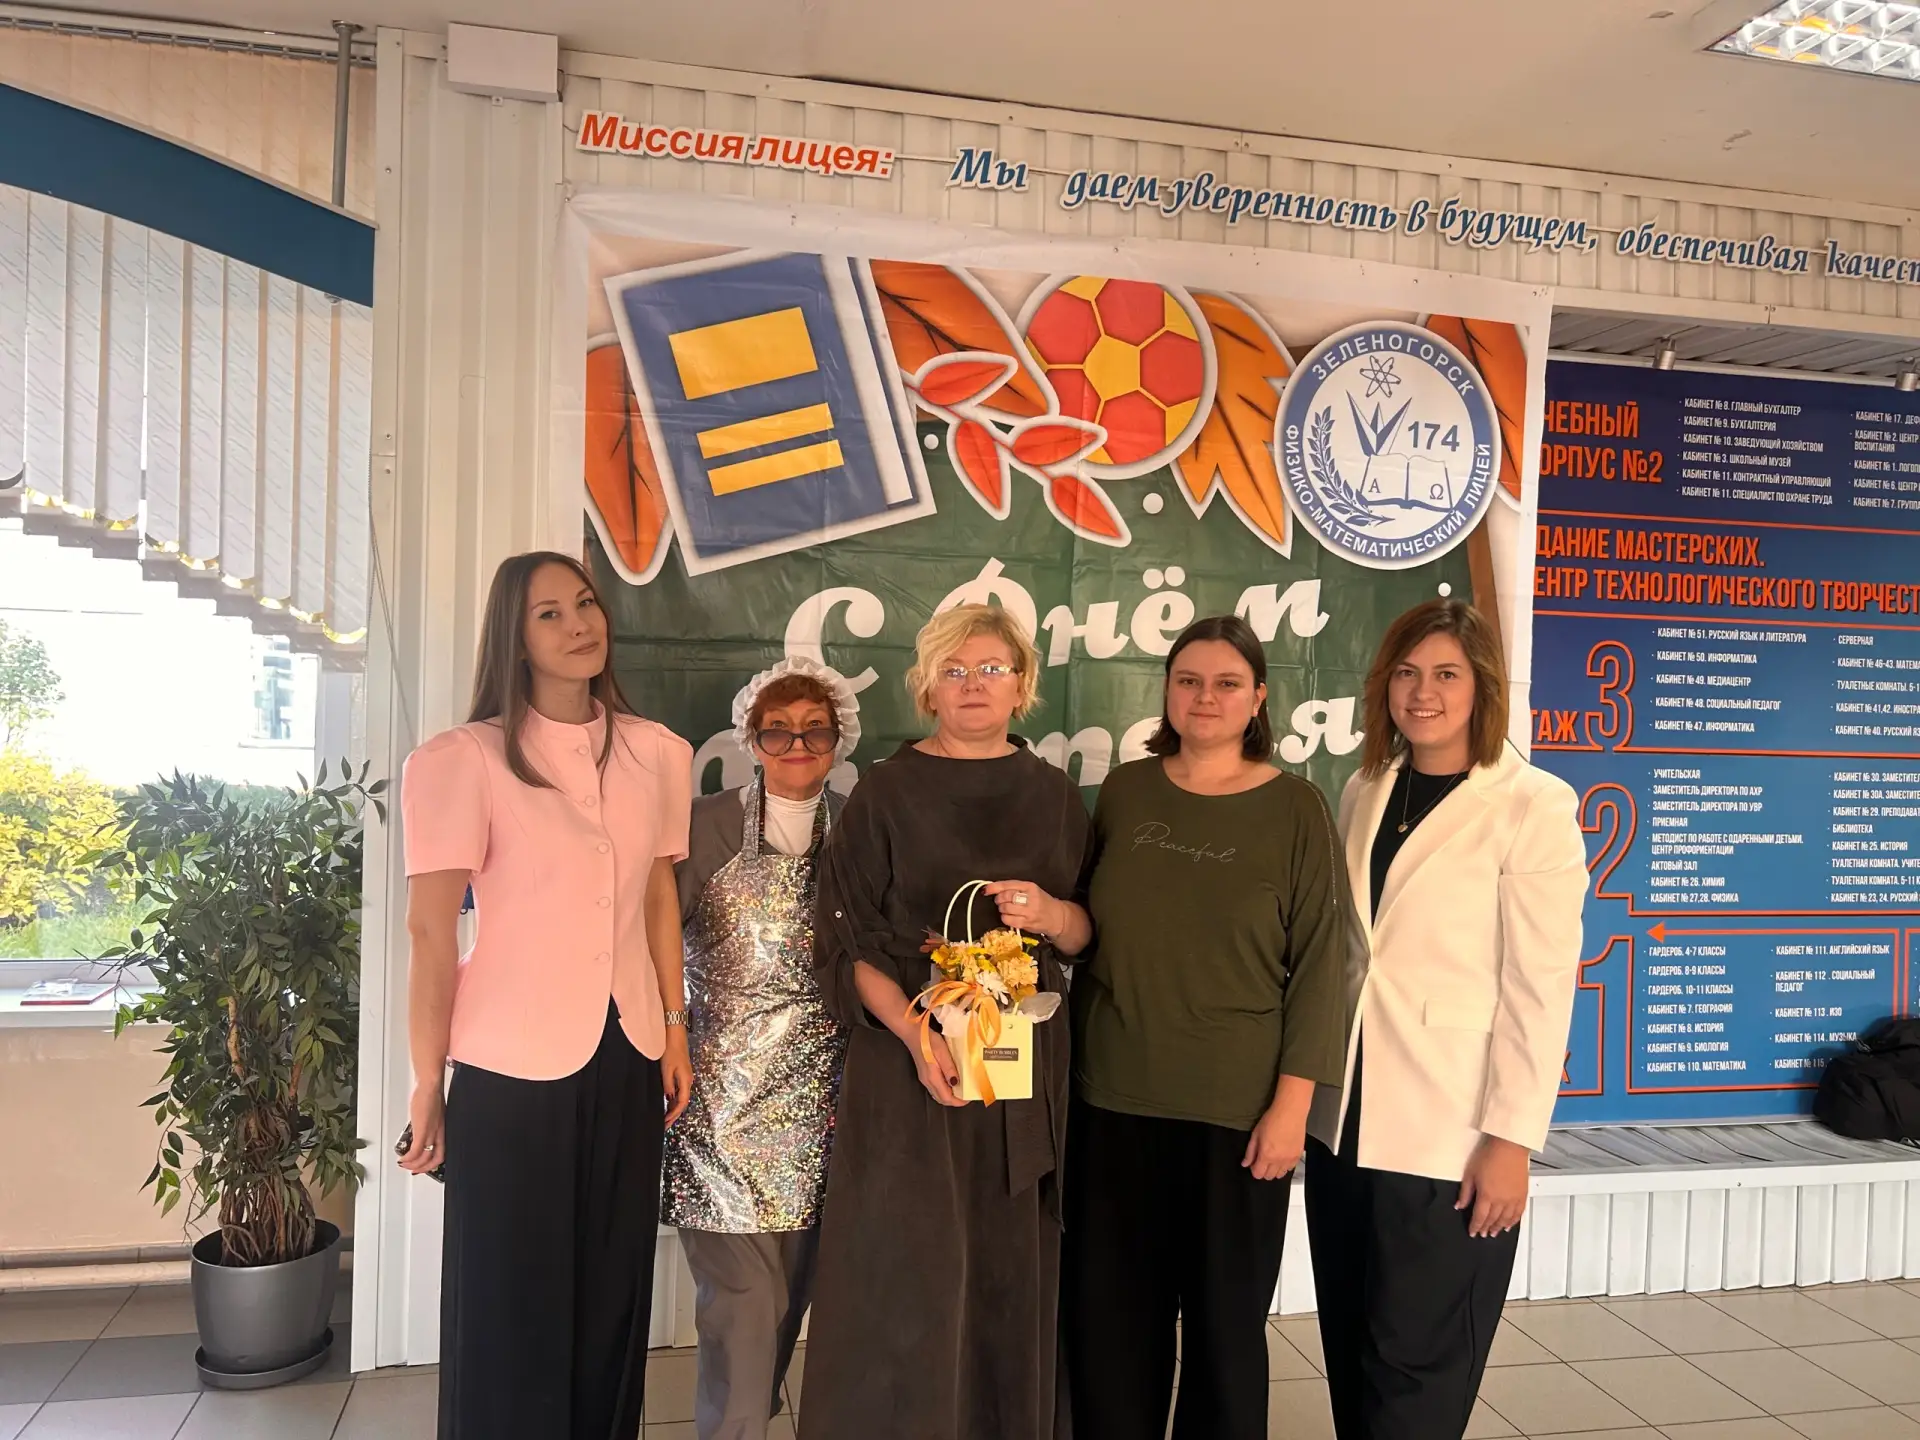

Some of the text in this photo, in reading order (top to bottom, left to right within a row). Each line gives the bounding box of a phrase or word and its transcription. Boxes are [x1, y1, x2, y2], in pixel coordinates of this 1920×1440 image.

[580, 114, 892, 175] Миссия лицея:
[950, 148, 1028, 188] Мы
[1065, 172, 1158, 207] даем
[1164, 173, 1397, 229] уверенность
[1407, 201, 1431, 232] в
[1439, 198, 1598, 250] будущем,
[1619, 218, 1808, 272] обеспечивая
[1312, 334, 1474, 396] ЗЕЛЕНОГОРСК
[1685, 398, 1714, 409] КАБИНЕТ
[1715, 401, 1722, 410] №
[1731, 400, 1762, 412] ГЛАВНЫЙ
[1764, 404, 1801, 415] БУХГАЛТЕР
[1684, 416, 1713, 427] КАБИНЕТ
[1715, 418, 1721, 427] №
[1731, 419, 1776, 431] БУХГАЛТЕРИЯ
[1407, 421, 1460, 452] 174
[1684, 434, 1712, 445] КАБИНЕТ
[1714, 436, 1721, 445] №
[1734, 436, 1780, 450] ЗАВЕДУЮЩИЙ
[1782, 439, 1823, 452] ХОЗЯЙСТВОМ
[1683, 452, 1712, 462] КАБИНЕТ
[1713, 453, 1720, 463] №
[1730, 453, 1767, 466] ШКОЛЬНЫЙ
[1769, 456, 1791, 467] МУЗЕЙ
[1623, 449, 1663, 482] №2
[1683, 469, 1711, 480] КАБИНЕТ
[1713, 471, 1720, 480] №
[1733, 471, 1779, 484] КОНТРАКТНЫЙ
[1781, 474, 1831, 488] УПРАВЛЯЮЩИЙ
[1286, 425, 1491, 557] ФИЗИКО-МАТЕМАТИЧЕСКИЙ ЛИЦЕЙ
[1682, 487, 1711, 497] КАБИНЕТ
[1713, 489, 1719, 498] №
[1733, 490, 1774, 502] СПЕЦИАЛИСТ
[1776, 492, 1784, 501] ПО
[1786, 493, 1810, 503] ОХРАНЕ
[1812, 494, 1832, 505] ТРУДА
[1616, 530, 1765, 567] МАСТЕРСКИХ.
[1593, 569, 1815, 609] ТЕХНОЛОГИЧЕСКОГО
[1658, 628, 1687, 638] КАБИНЕТ
[1688, 629, 1695, 638] №
[1709, 629, 1738, 640] РУССКИЙ
[1740, 631, 1758, 641] ЯЗЫК
[1765, 632, 1806, 642] ЛИТЕРАТУРА
[1839, 635, 1873, 645] СЕРВЕРНАЯ
[1657, 651, 1686, 661] КАБИНЕТ
[1688, 652, 1695, 661] №
[1708, 653, 1757, 663] ИНФОРМАТИКА
[1656, 675, 1685, 684] КАБИНЕТ
[1687, 676, 1694, 684] №
[1707, 676, 1751, 687] МЕДИАЦЕНТР
[1585, 640, 1635, 748] 3
[1656, 698, 1685, 707] КАБИНЕТ
[1686, 699, 1693, 708] №
[1706, 698, 1750, 710] СОЦИАЛЬНЫЙ
[1752, 700, 1781, 711] ПЕДАГОГ
[1655, 721, 1684, 730] КАБИНЕТ
[1686, 722, 1692, 731] №
[1706, 722, 1754, 732] ИНФОРМАТИКА
[1654, 769, 1700, 779] УЧИТЕЛЬСКАЯ
[1653, 786, 1762, 796] ЗАМЕСТИТЕЛЬ ДИРЕКТОРА ПО АХР
[1653, 802, 1762, 812] ЗАМЕСТИТЕЛЬ ДИРЕКТОРА ПО УВР
[1653, 818, 1687, 826] ПРИЕМНАЯ
[1833, 824, 1872, 833] БИБЛИОТЕКА
[1652, 834, 1686, 843] МЕТОДИСТ
[1688, 834, 1696, 843] ПО
[1698, 834, 1721, 843] РАБОТЕ
[1729, 834, 1774, 844] ОДАРЕННЫМИ
[1775, 834, 1803, 844] ДЕТЬМИ.
[1652, 845, 1734, 855] ЦЕНТР ПРОФОРИЕНТАЦИИ
[1832, 842, 1860, 850] КАБИНЕТ
[1861, 842, 1868, 850] №
[1880, 842, 1907, 850] ИСТОРИЯ
[1651, 860, 1697, 870] АКТОВЫЙ ЗАЛ
[1651, 877, 1680, 886] КАБИНЕТ
[1681, 877, 1689, 886] №
[1702, 877, 1724, 886] ХИМИЯ
[1651, 893, 1739, 903] КАБИНЕТ № 27,28. ФИЗИКА
[1649, 947, 1726, 957] ГАРДЕРОБ. 4-7 КЛАССЫ
[1776, 946, 1804, 954] КАБИНЕТ
[1806, 945, 1813, 954] №
[1830, 944, 1871, 954] АНГЛИЙСКИЙ
[1872, 945, 1889, 954] ЯЗЫК
[1649, 966, 1725, 976] ГАРДЕРОБ. 8-9 КЛАССЫ
[1648, 985, 1733, 995] ГАРДЕРОБ. 10-11 КЛАССЫ
[1577, 935, 1634, 1094] 1
[1648, 1004, 1677, 1014] КАБИНЕТ
[1679, 1004, 1686, 1013] №
[1695, 1004, 1732, 1013] ГЕОГРАФИЯ
[1648, 1024, 1677, 1033] КАБИНЕТ
[1678, 1024, 1686, 1033] №
[1695, 1023, 1723, 1032] ИСТОРИЯ
[1647, 1043, 1676, 1052] КАБИНЕТ
[1678, 1043, 1685, 1052] №
[1694, 1042, 1728, 1051] БИОЛОГИЯ
[1647, 1062, 1676, 1072] КАБИНЕТ
[1678, 1062, 1685, 1071] №
[1703, 1061, 1746, 1071] МАТЕМАТИКА
